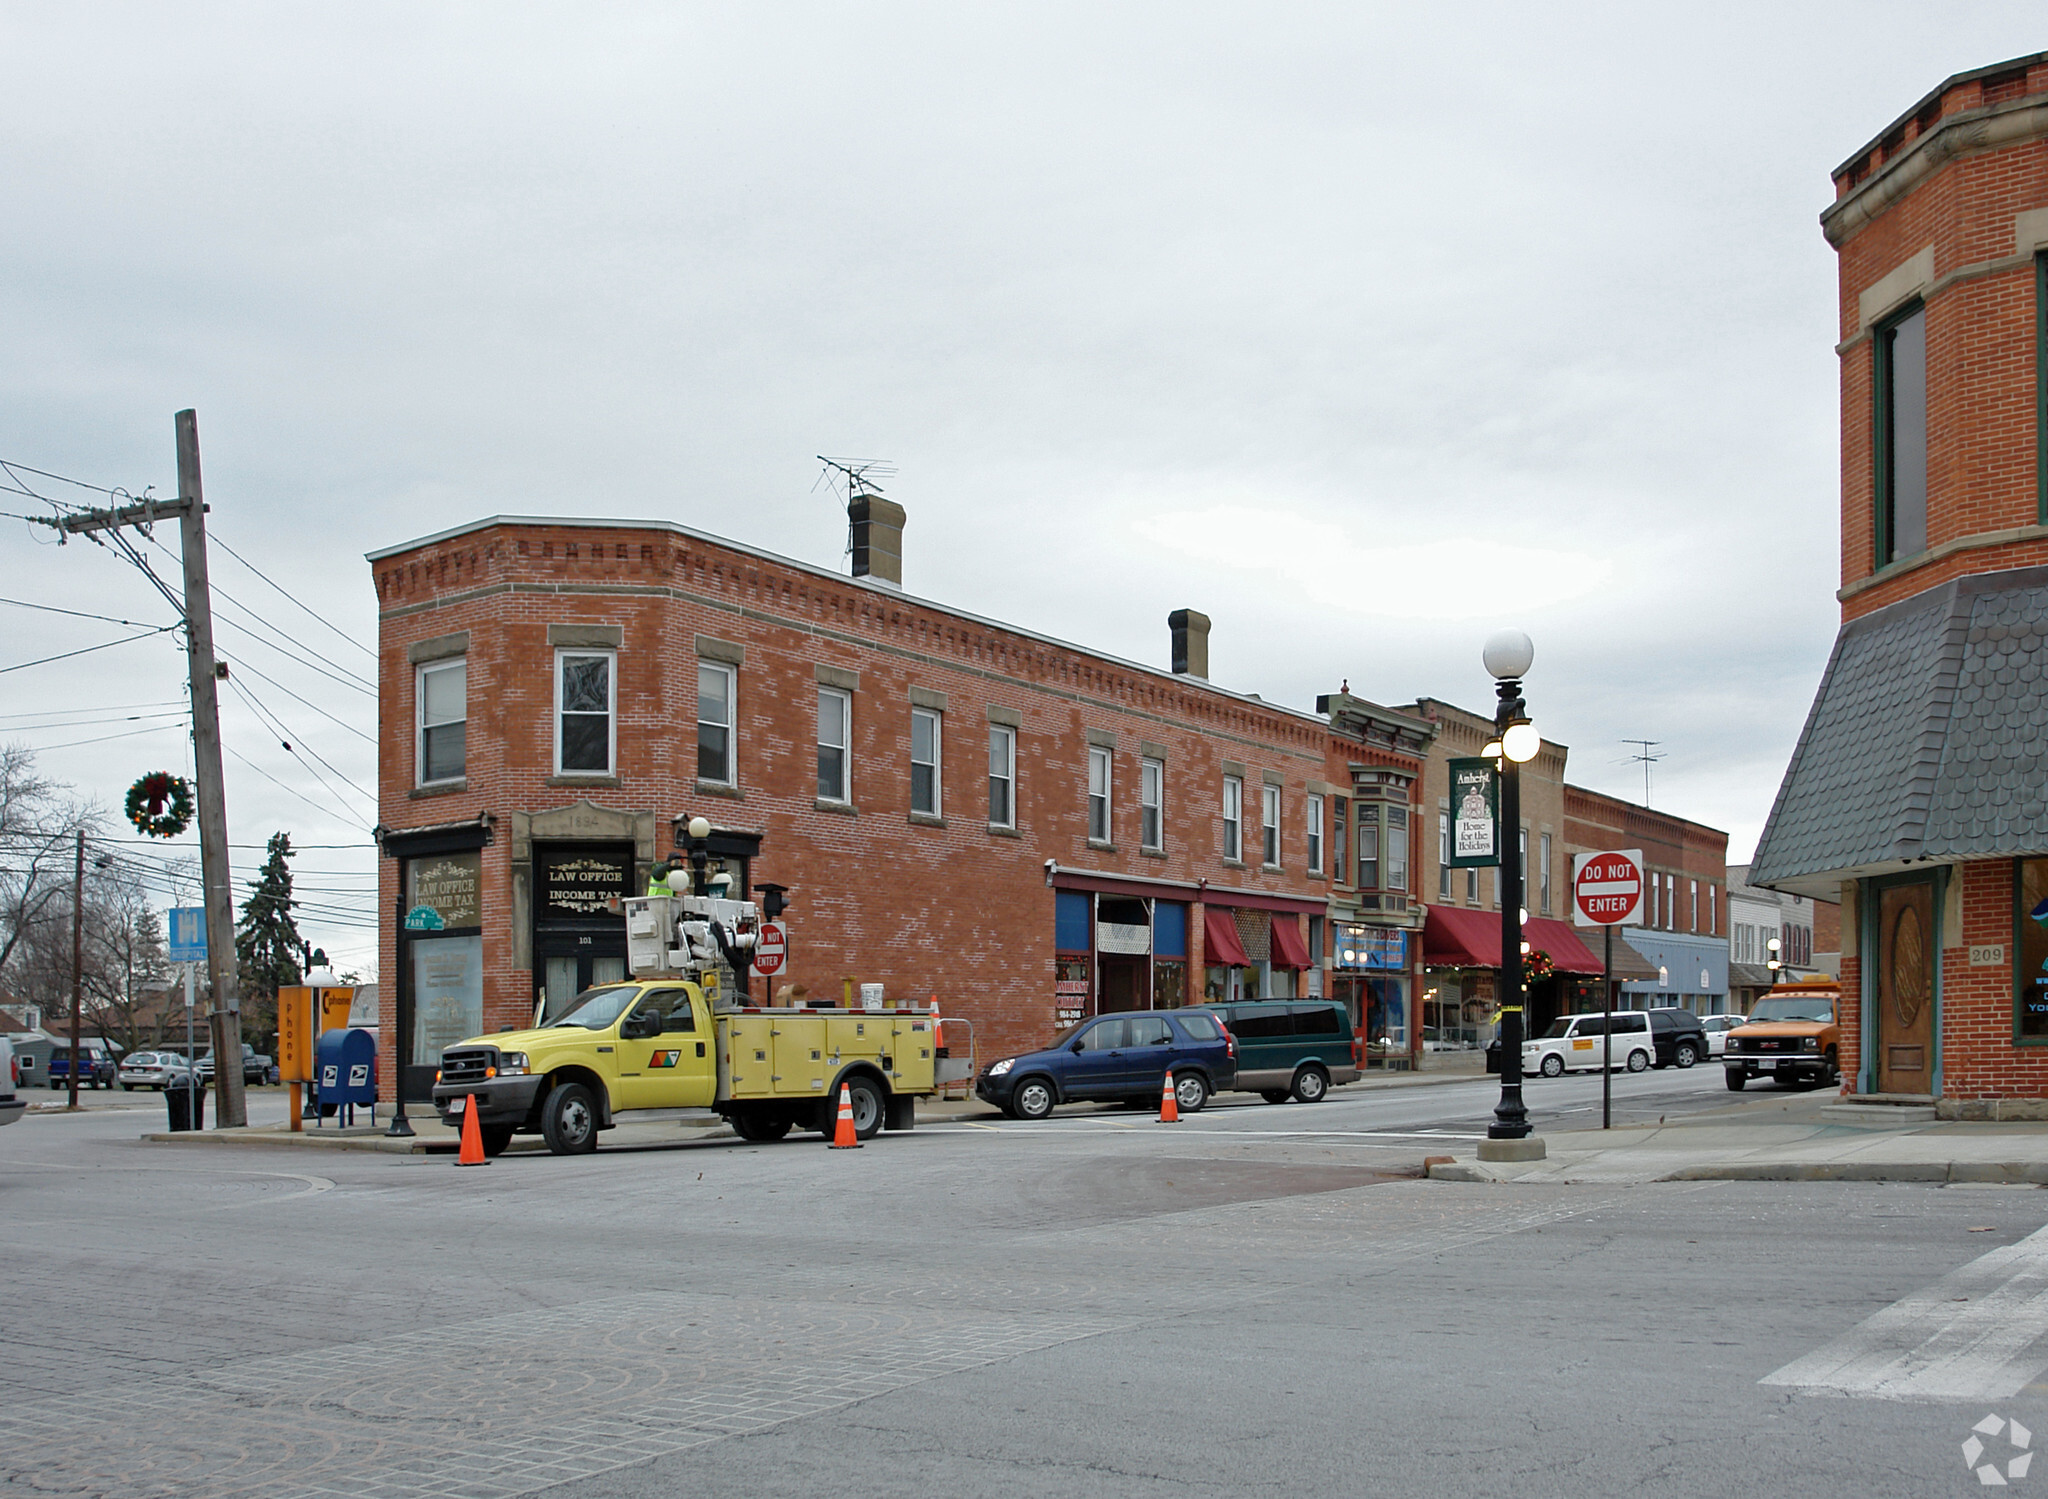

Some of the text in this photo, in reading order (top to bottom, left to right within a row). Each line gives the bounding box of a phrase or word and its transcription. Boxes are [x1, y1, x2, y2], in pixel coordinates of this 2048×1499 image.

[1457, 771, 1490, 785] Amherst
[1463, 822, 1486, 831] Home
[1461, 831, 1488, 841] for the
[1458, 841, 1491, 853] Holidays
[549, 872, 622, 882] LAW OFFICE
[1585, 863, 1632, 880] DO NOT
[416, 879, 475, 896] LAW OFFICE
[549, 890, 622, 899] INCOME TAX
[454, 894, 475, 907] TAX
[1588, 897, 1628, 913] ENTER
[178, 912, 198, 944] H
[405, 918, 425, 928] PARK
[579, 936, 592, 945] 101
[767, 932, 780, 943] NOT
[1972, 948, 2002, 962] 209
[757, 956, 779, 967] ENTER
[328, 995, 351, 1006] phone
